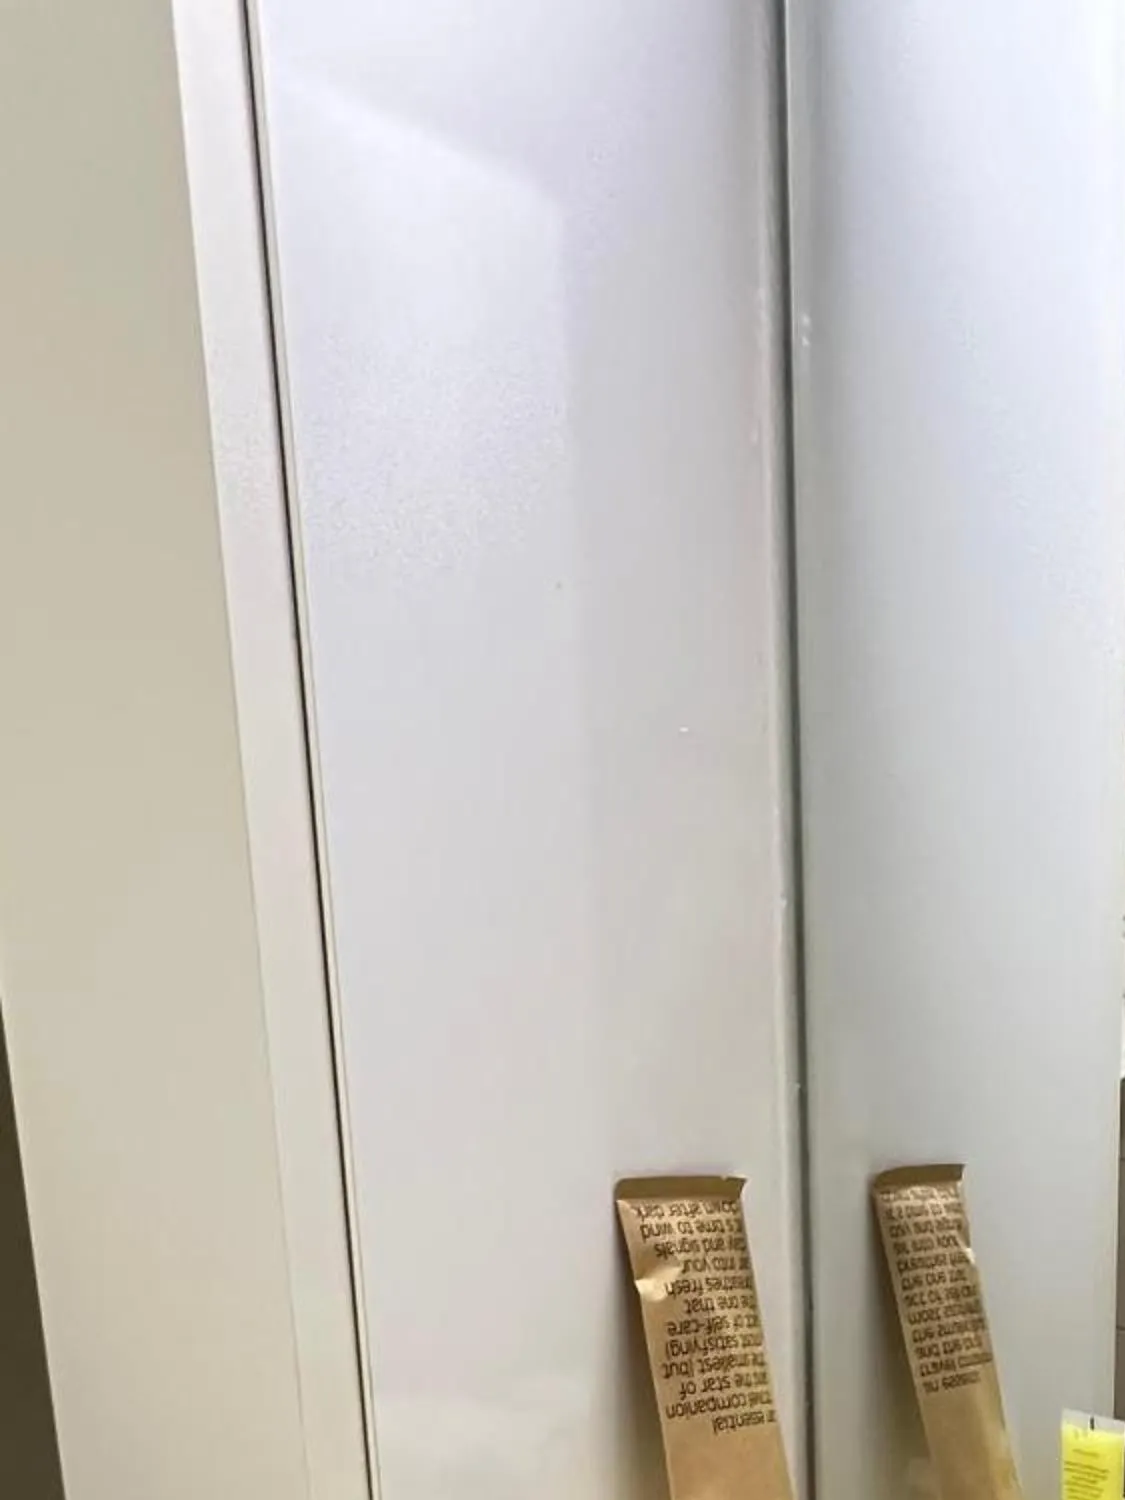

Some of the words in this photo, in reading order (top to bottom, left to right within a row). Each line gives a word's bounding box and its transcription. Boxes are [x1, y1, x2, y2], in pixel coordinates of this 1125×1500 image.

[637, 1204, 665, 1221] dark
[669, 1200, 702, 1218] after
[640, 1222, 675, 1243] wind
[677, 1221, 695, 1235] to
[654, 1237, 700, 1260] signals
[701, 1238, 725, 1253] and
[681, 1255, 712, 1273] your
[664, 1279, 703, 1297] fresh
[684, 1297, 715, 1314] that
[664, 1316, 730, 1336] self-care
[698, 1353, 751, 1374] smallest
[680, 1381, 697, 1400] of
[701, 1376, 731, 1393] star
[665, 1393, 747, 1420] companion
